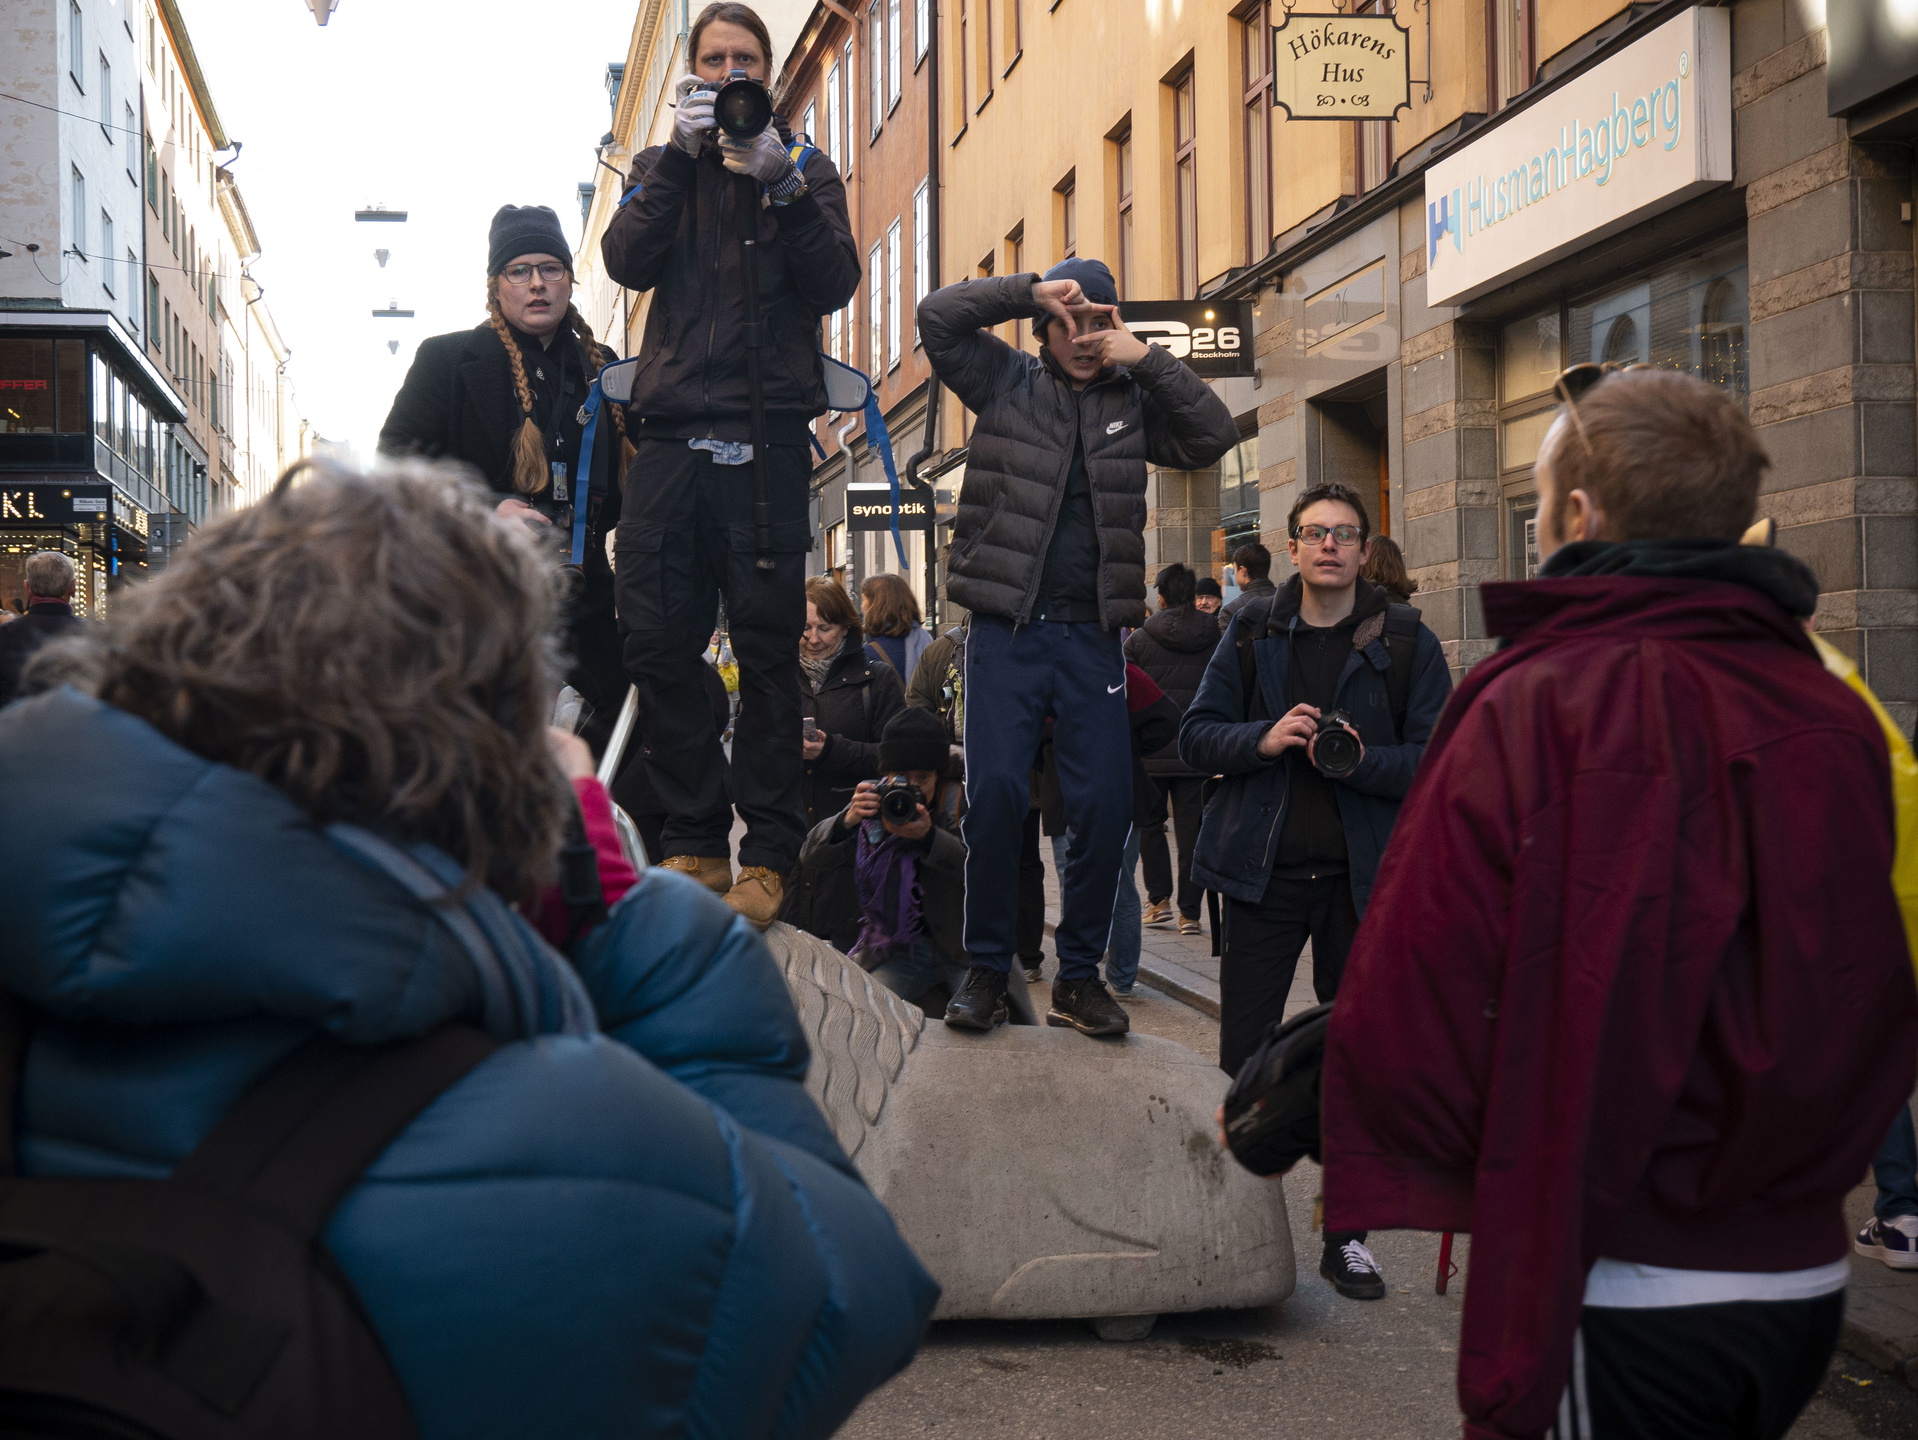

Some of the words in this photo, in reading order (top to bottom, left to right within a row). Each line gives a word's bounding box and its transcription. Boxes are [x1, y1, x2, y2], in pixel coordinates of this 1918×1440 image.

[1287, 22, 1396, 61] Hökarens
[1320, 62, 1365, 83] Hus
[1335, 287, 1349, 327] 26
[1191, 351, 1240, 359] Stockholm
[0, 379, 47, 390] FFER
